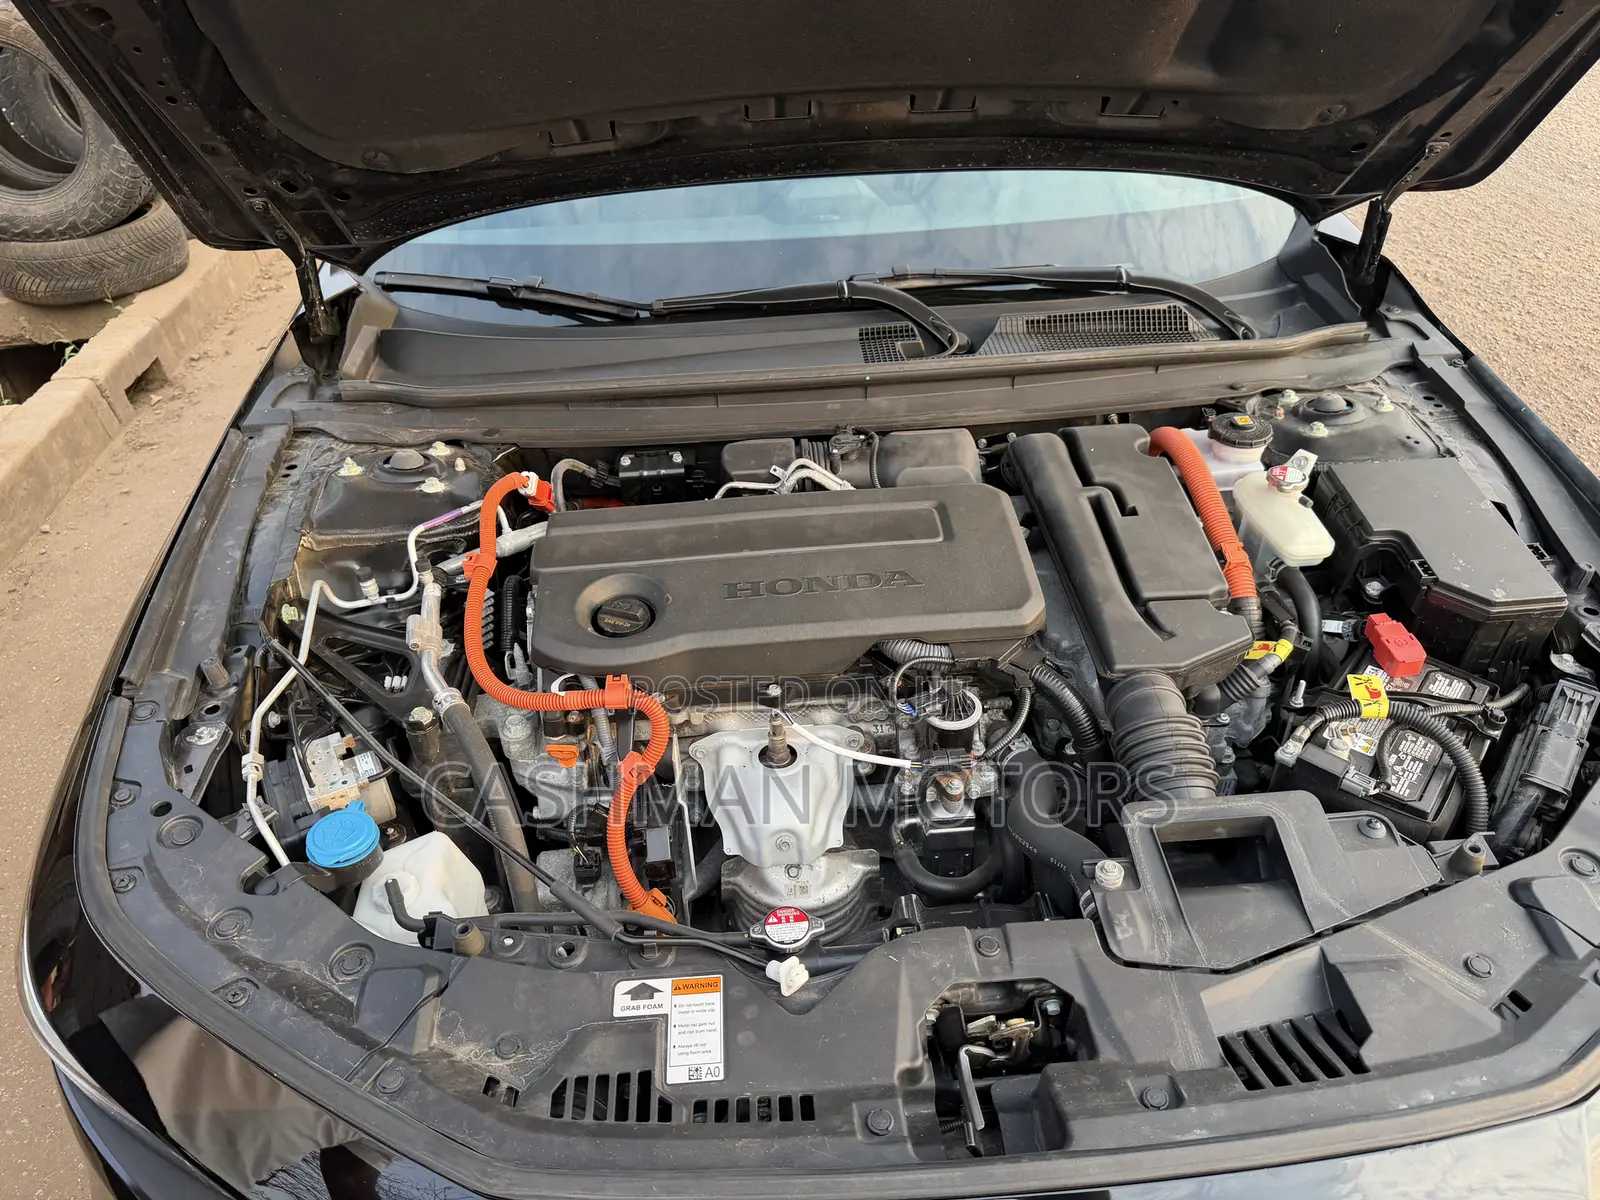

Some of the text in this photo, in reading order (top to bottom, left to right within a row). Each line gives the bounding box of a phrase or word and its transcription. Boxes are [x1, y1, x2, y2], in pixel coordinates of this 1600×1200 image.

[723, 570, 926, 600] HONDA
[872, 723, 892, 734] 317
[681, 981, 719, 990] WARNING
[704, 1066, 721, 1079] A0
